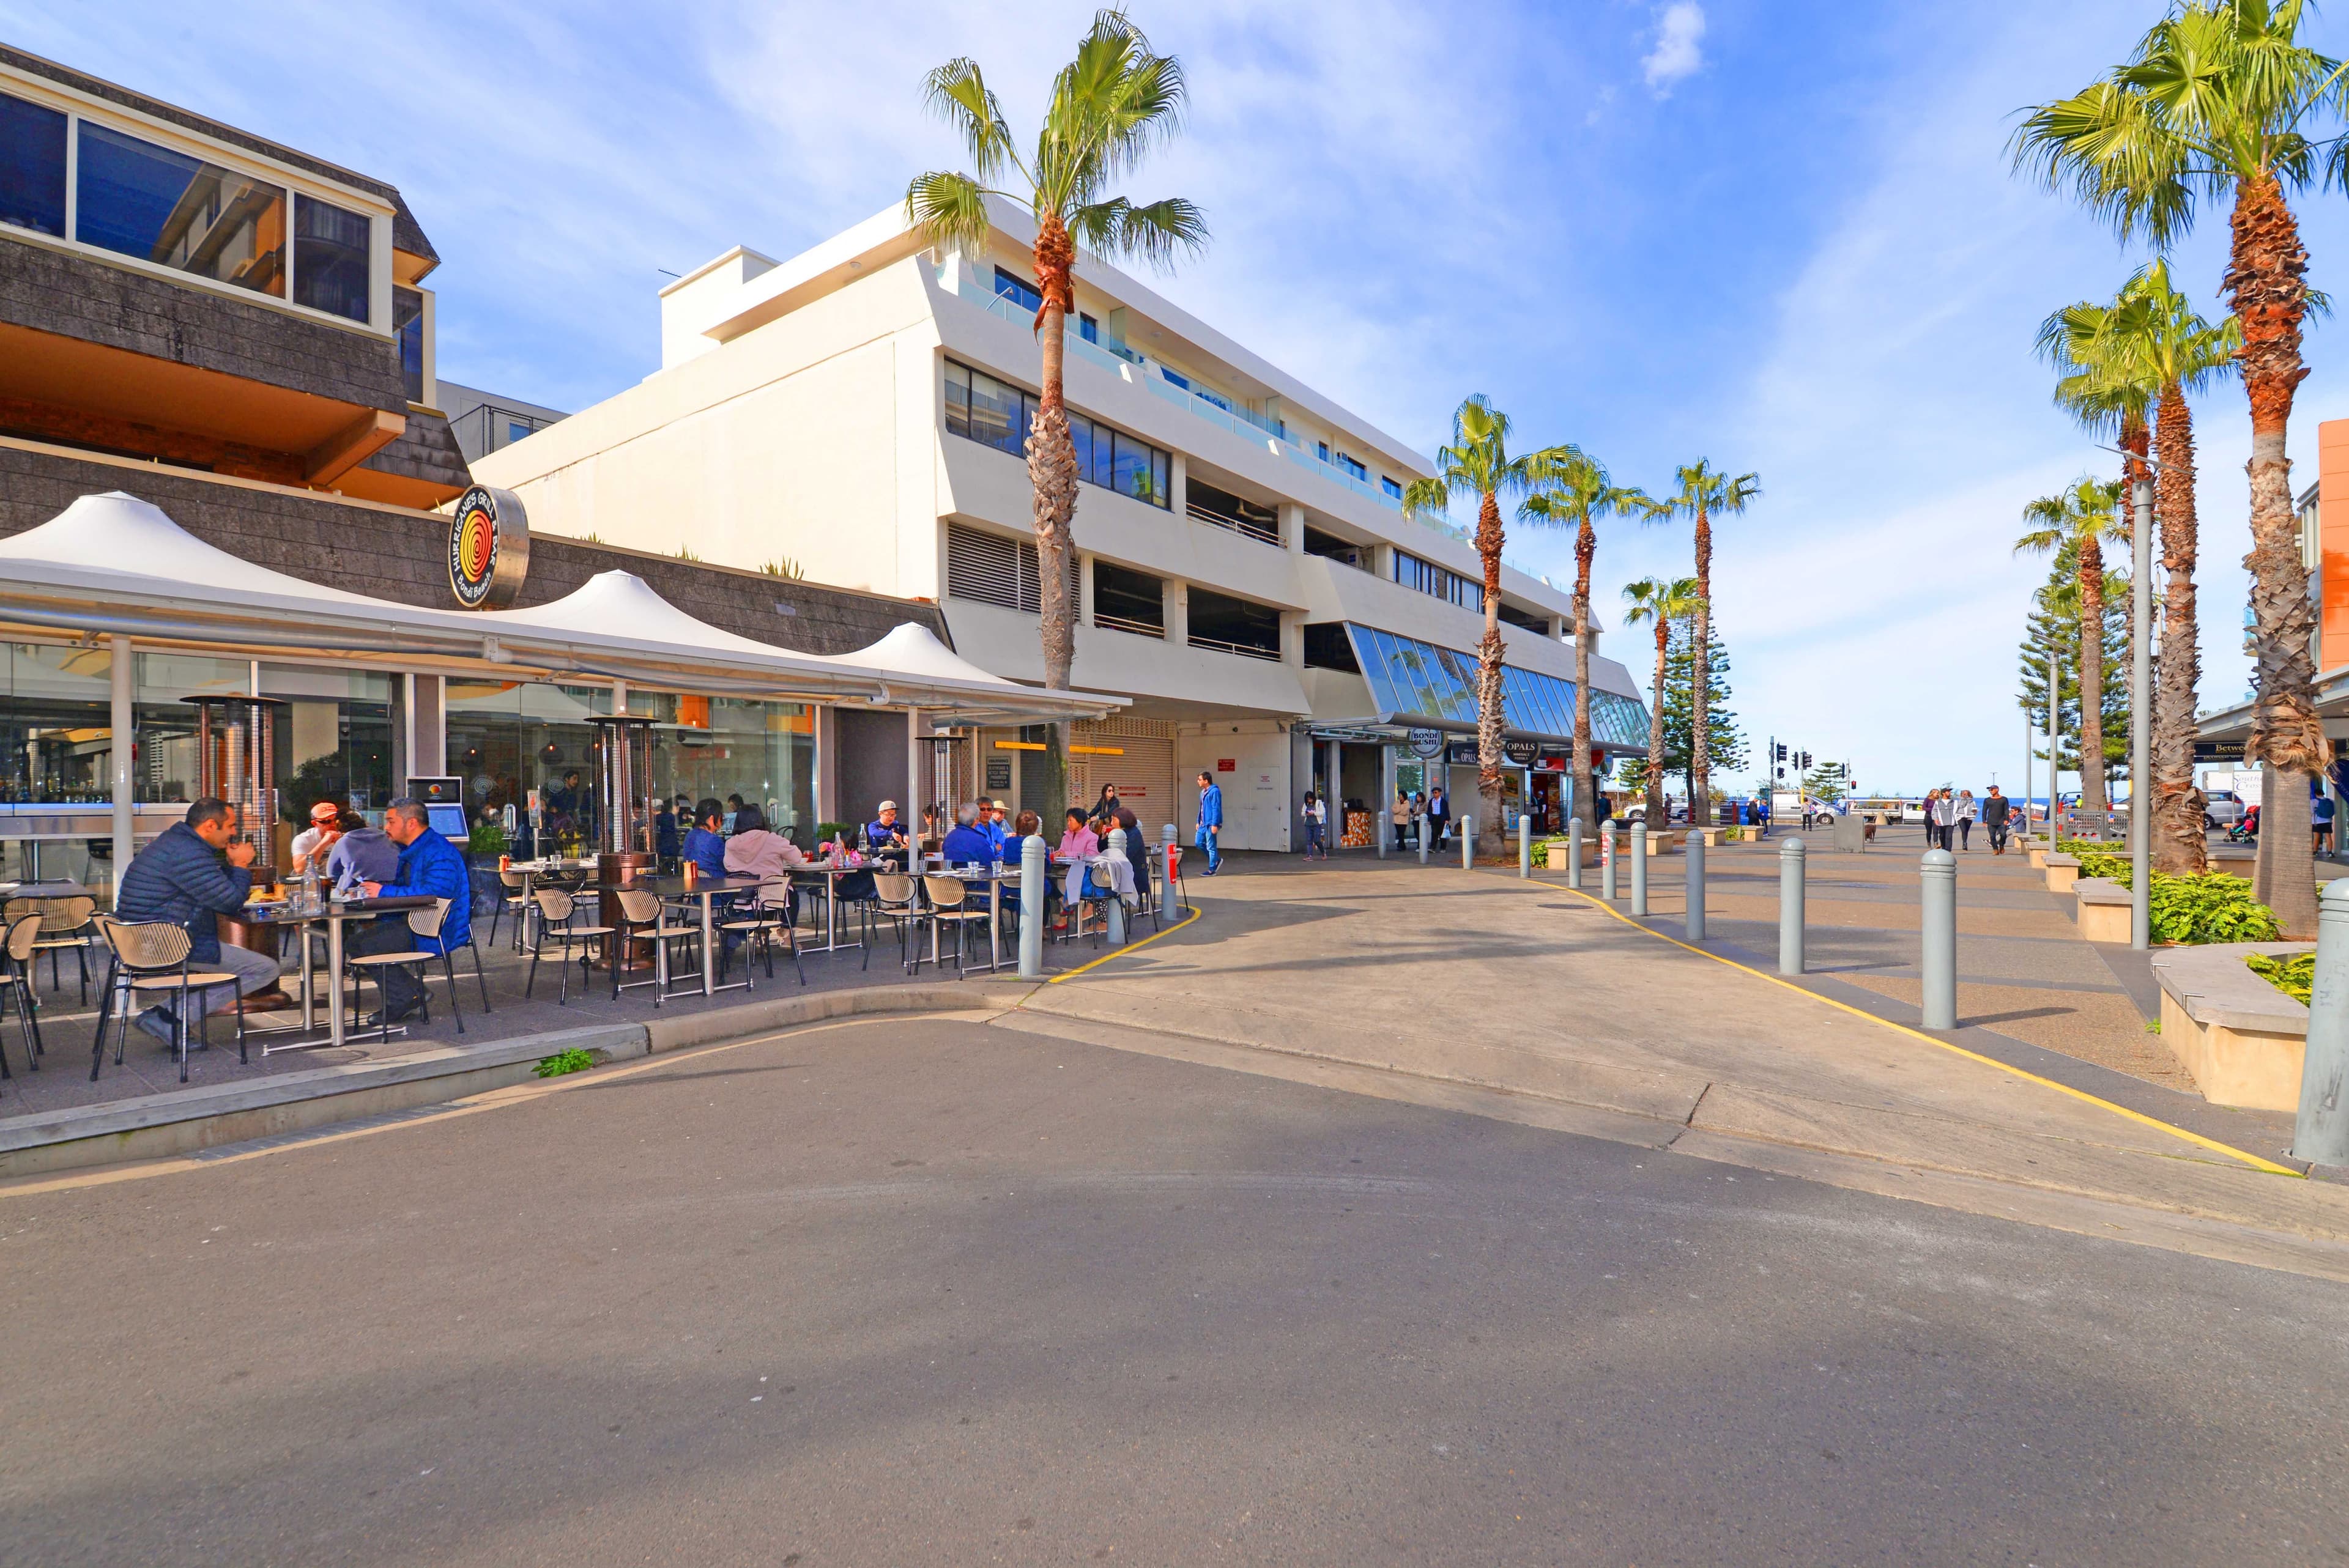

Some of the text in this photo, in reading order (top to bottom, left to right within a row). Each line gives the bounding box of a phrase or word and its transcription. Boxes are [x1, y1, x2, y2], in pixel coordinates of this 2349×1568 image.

[453, 492, 477, 572] HURRICANE'S
[478, 492, 494, 519] GRILL
[492, 520, 497, 531] &
[457, 572, 491, 598] Bondi Beach
[1461, 753, 1477, 763] OPALS
